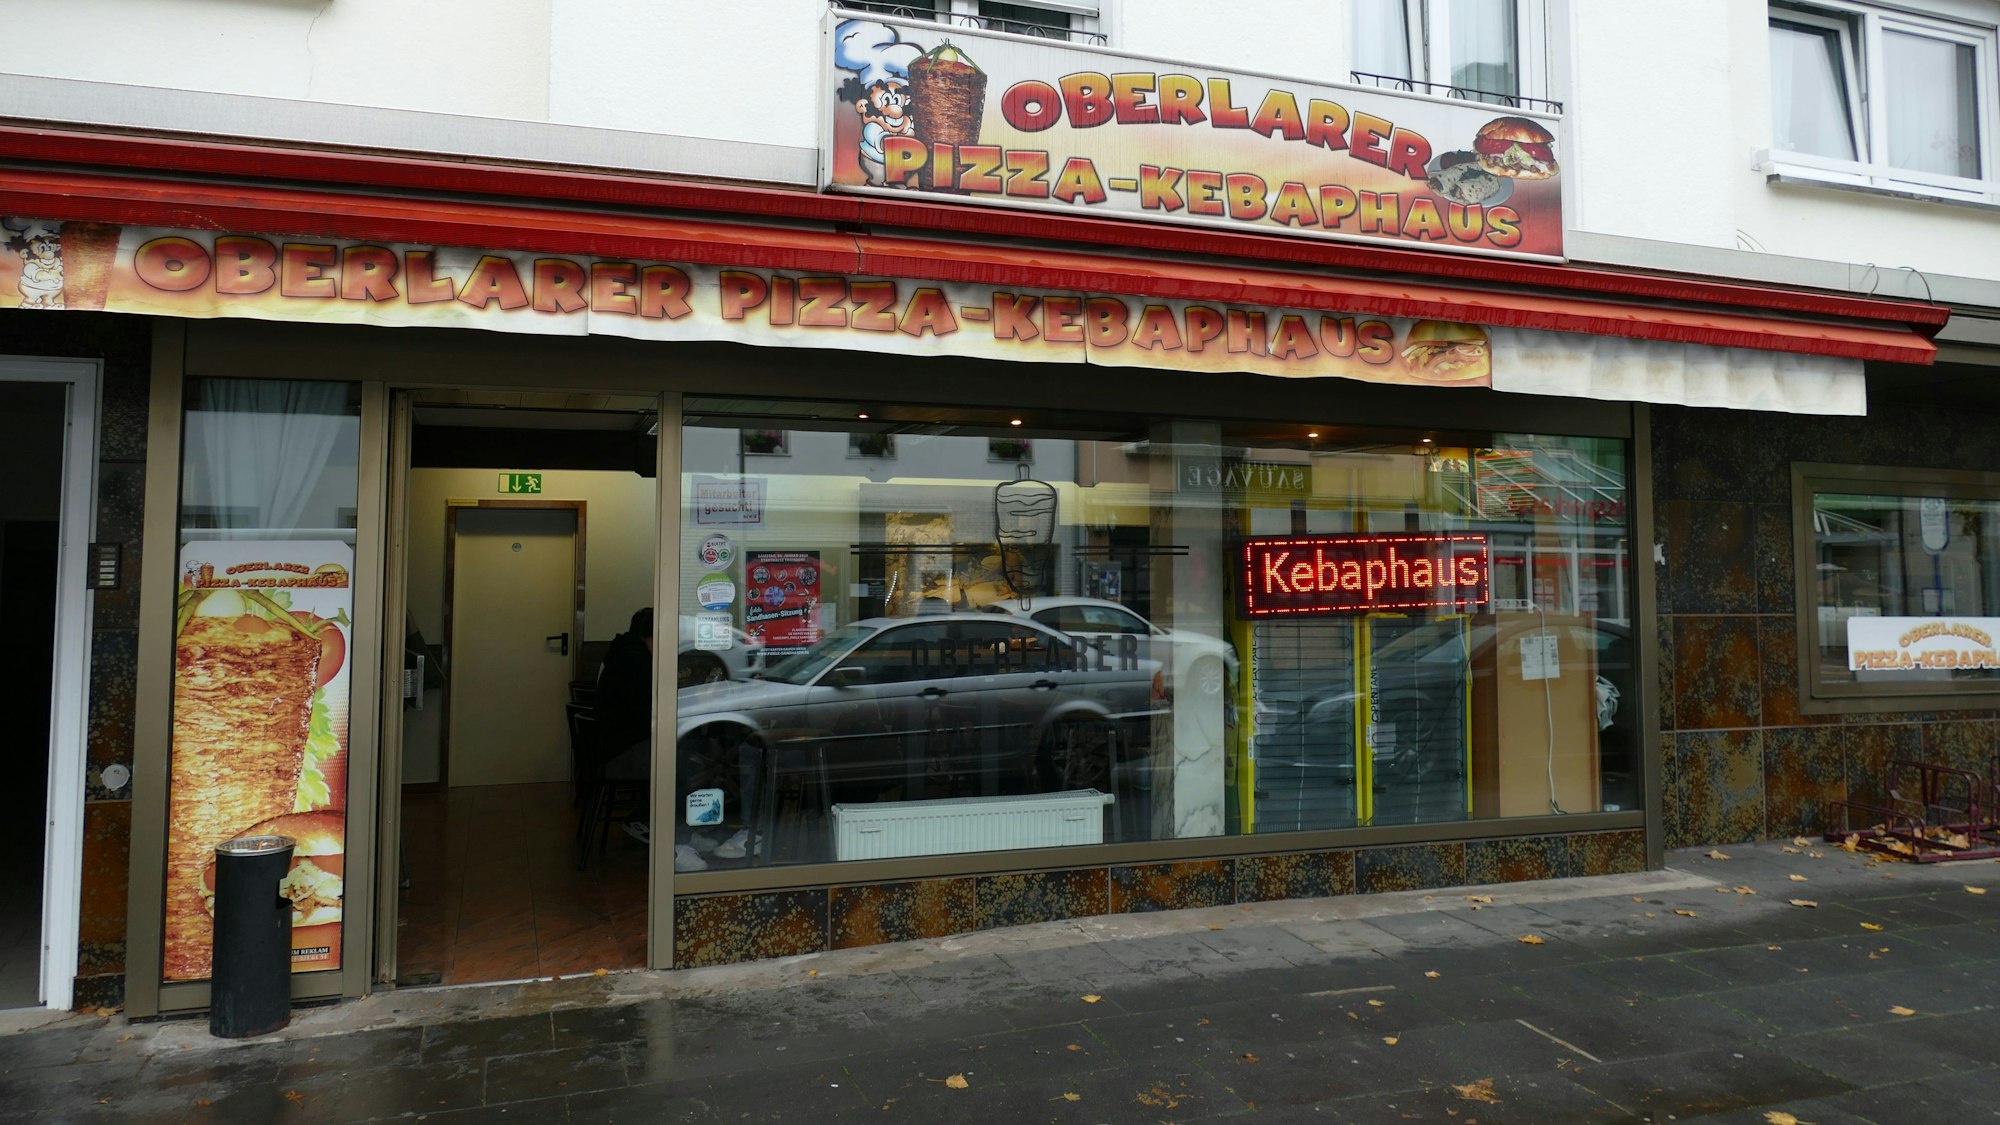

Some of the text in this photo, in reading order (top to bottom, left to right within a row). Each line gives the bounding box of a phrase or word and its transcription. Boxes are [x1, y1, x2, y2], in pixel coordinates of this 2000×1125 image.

[1001, 71, 1438, 182] OBERLARER
[882, 136, 1525, 249] PIZZA-KEBAPHAUS
[134, 234, 1391, 366] OBERLARER PIZZA-KEBAPHAUS
[196, 577, 338, 588] PIZZA-KEBAPHAUS
[226, 562, 310, 575] OBERLARER
[1264, 548, 1480, 601] Kebaphaus
[746, 608, 803, 622] Sandhasen-Sitzung
[1898, 622, 1992, 648] OBERLARER
[909, 634, 1139, 677] OBERLARER
[1854, 649, 2000, 669] PIZZA-KEBAPH
